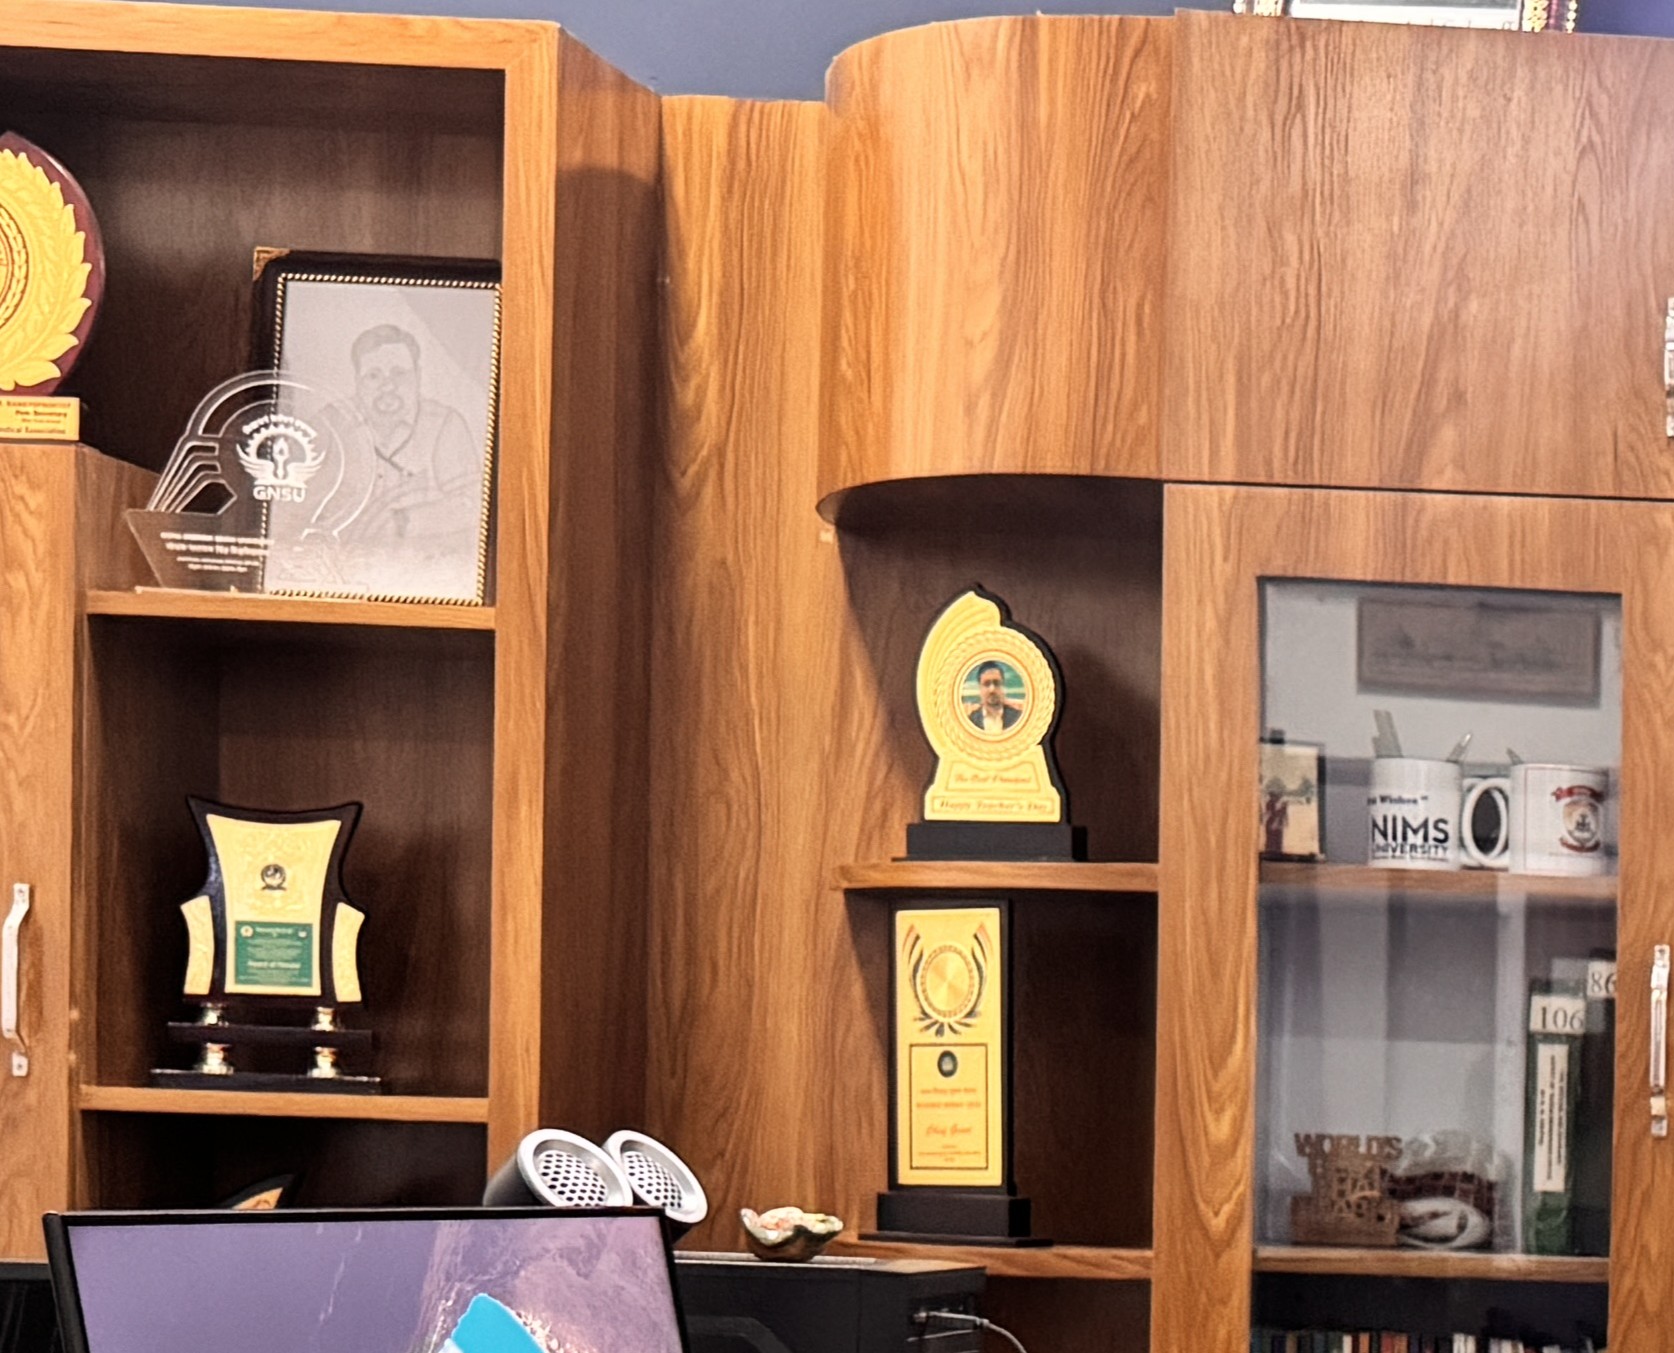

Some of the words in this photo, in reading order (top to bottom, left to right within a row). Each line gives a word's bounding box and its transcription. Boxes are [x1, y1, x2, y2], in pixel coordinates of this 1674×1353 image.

[253, 477, 306, 503] GNSU
[1371, 814, 1449, 844] NIMS
[1540, 1005, 1585, 1031] 106
